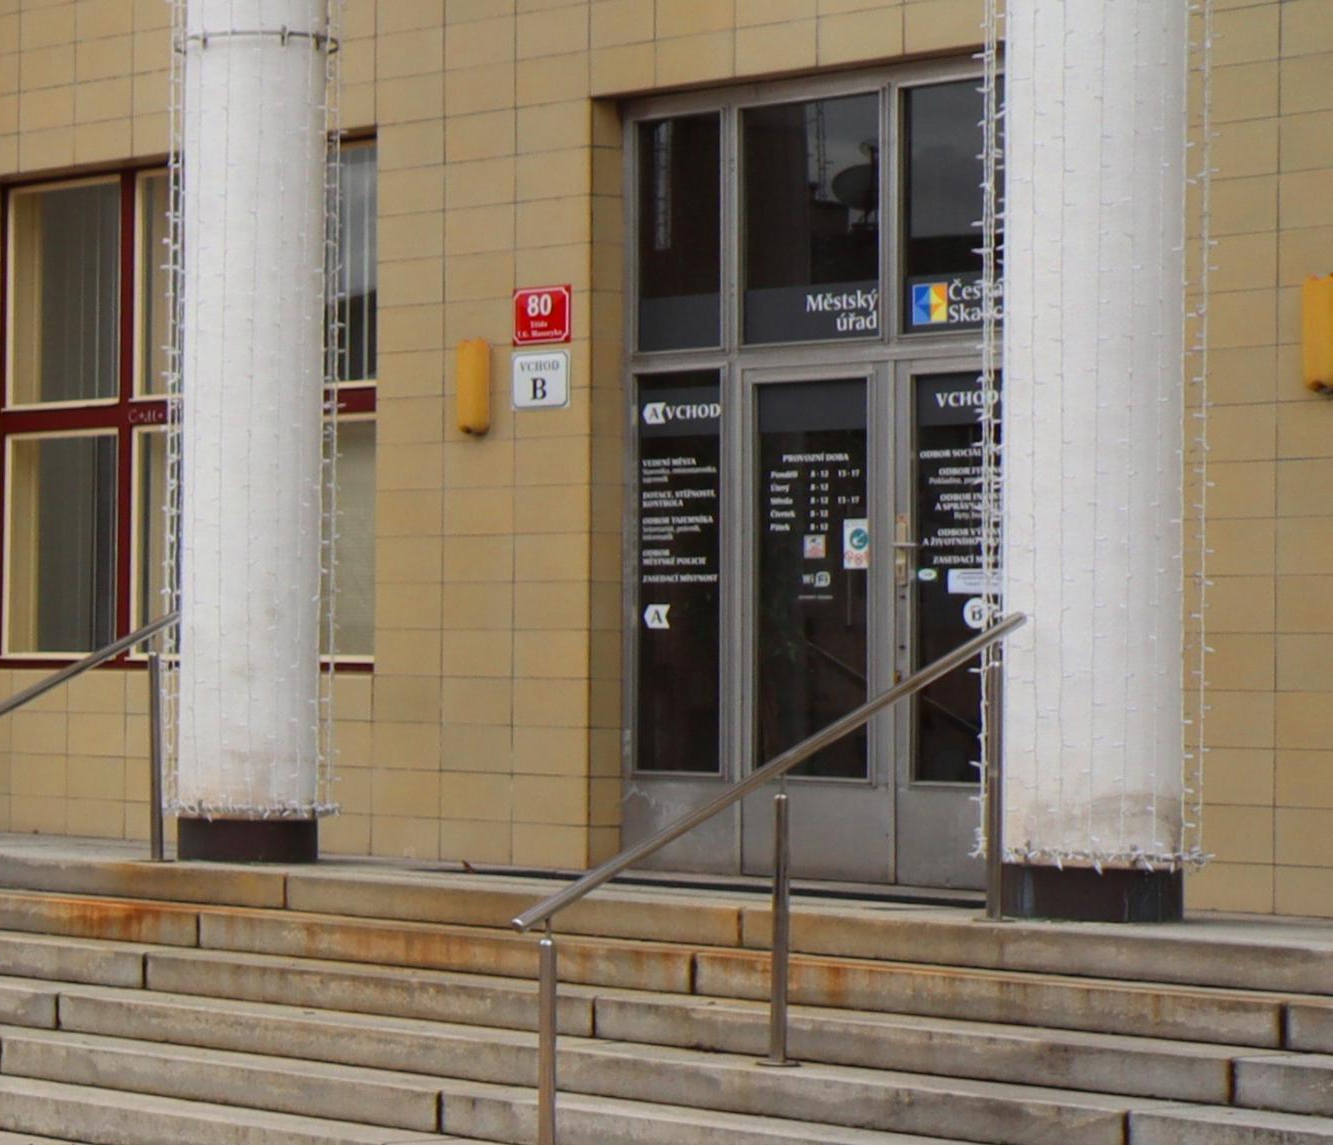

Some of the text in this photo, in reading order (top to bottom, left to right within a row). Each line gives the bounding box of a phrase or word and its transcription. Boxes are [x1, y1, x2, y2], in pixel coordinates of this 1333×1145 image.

[949, 278, 1003, 300] Česá
[527, 293, 552, 317] 80
[806, 289, 878, 312] Městský
[836, 311, 877, 332] úřad
[520, 360, 560, 372] VCHOD
[530, 377, 547, 401] B
[665, 403, 721, 420] VCHOD
